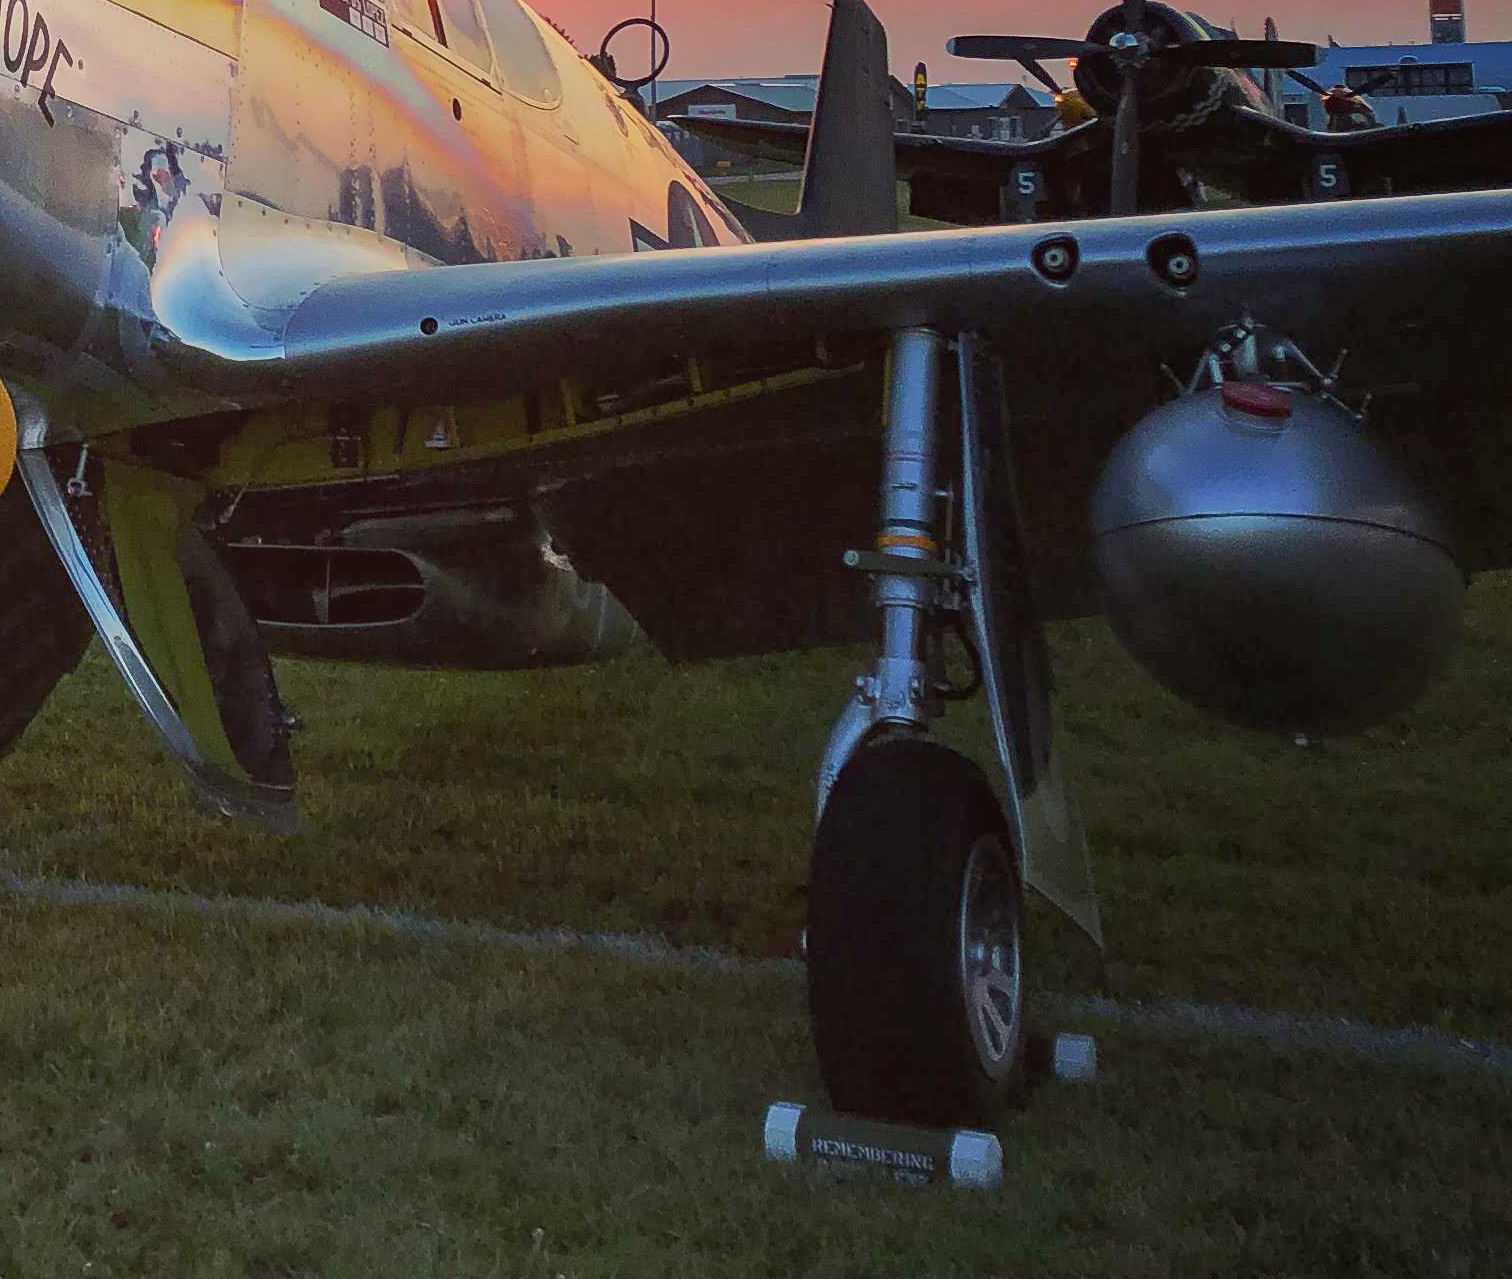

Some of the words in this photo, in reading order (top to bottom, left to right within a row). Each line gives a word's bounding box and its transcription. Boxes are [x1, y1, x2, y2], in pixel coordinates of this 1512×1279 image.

[1019, 172, 1035, 194] 5
[1320, 164, 1336, 188] 5
[469, 313, 507, 325] CAMERA
[811, 1137, 936, 1171] REMEMBERING
